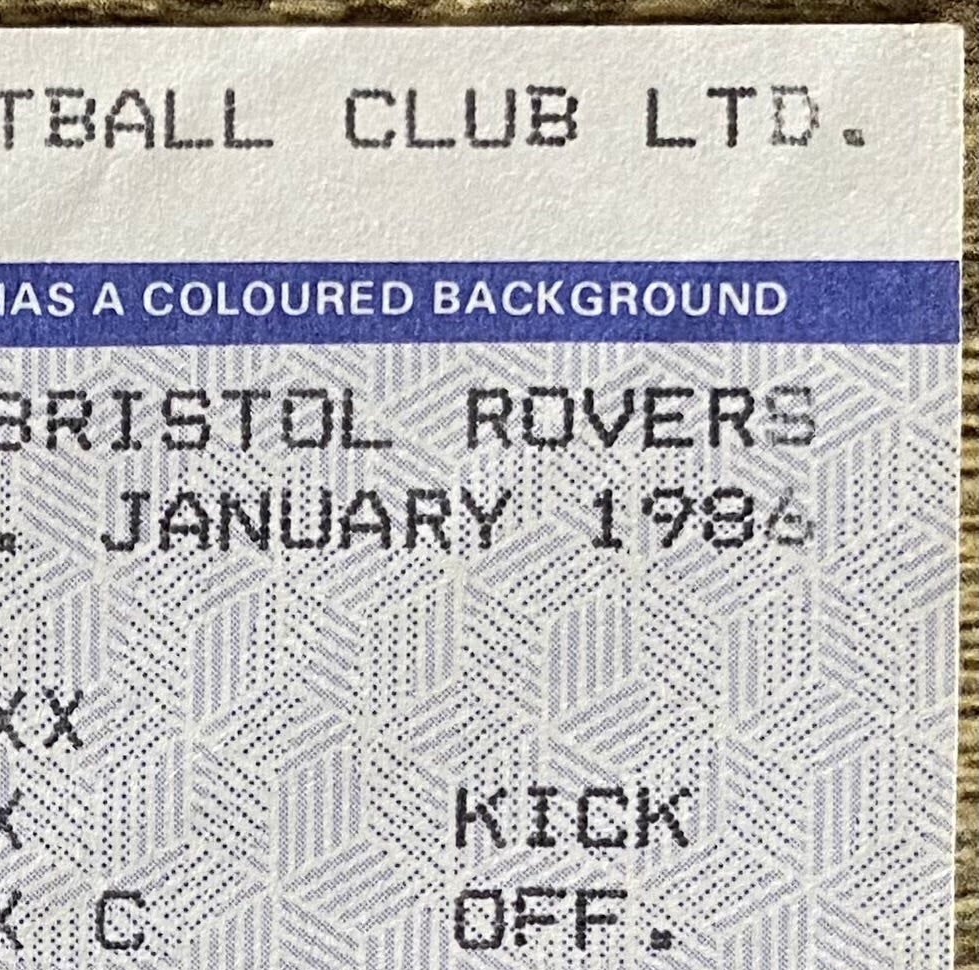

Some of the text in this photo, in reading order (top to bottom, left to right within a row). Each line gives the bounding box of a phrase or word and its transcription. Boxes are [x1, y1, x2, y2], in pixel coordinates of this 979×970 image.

[344, 84, 579, 149] CLUB
[645, 84, 866, 149] LTD.
[92, 282, 125, 316] A
[142, 281, 413, 317] COLOURED
[433, 280, 788, 317] BACKGROUND
[465, 385, 816, 451] ROVERS
[100, 488, 513, 553] JANUARY
[589, 488, 816, 550] 1986
[453, 785, 693, 849] KICK
[93, 889, 146, 952] C
[453, 888, 674, 952] OFF.
